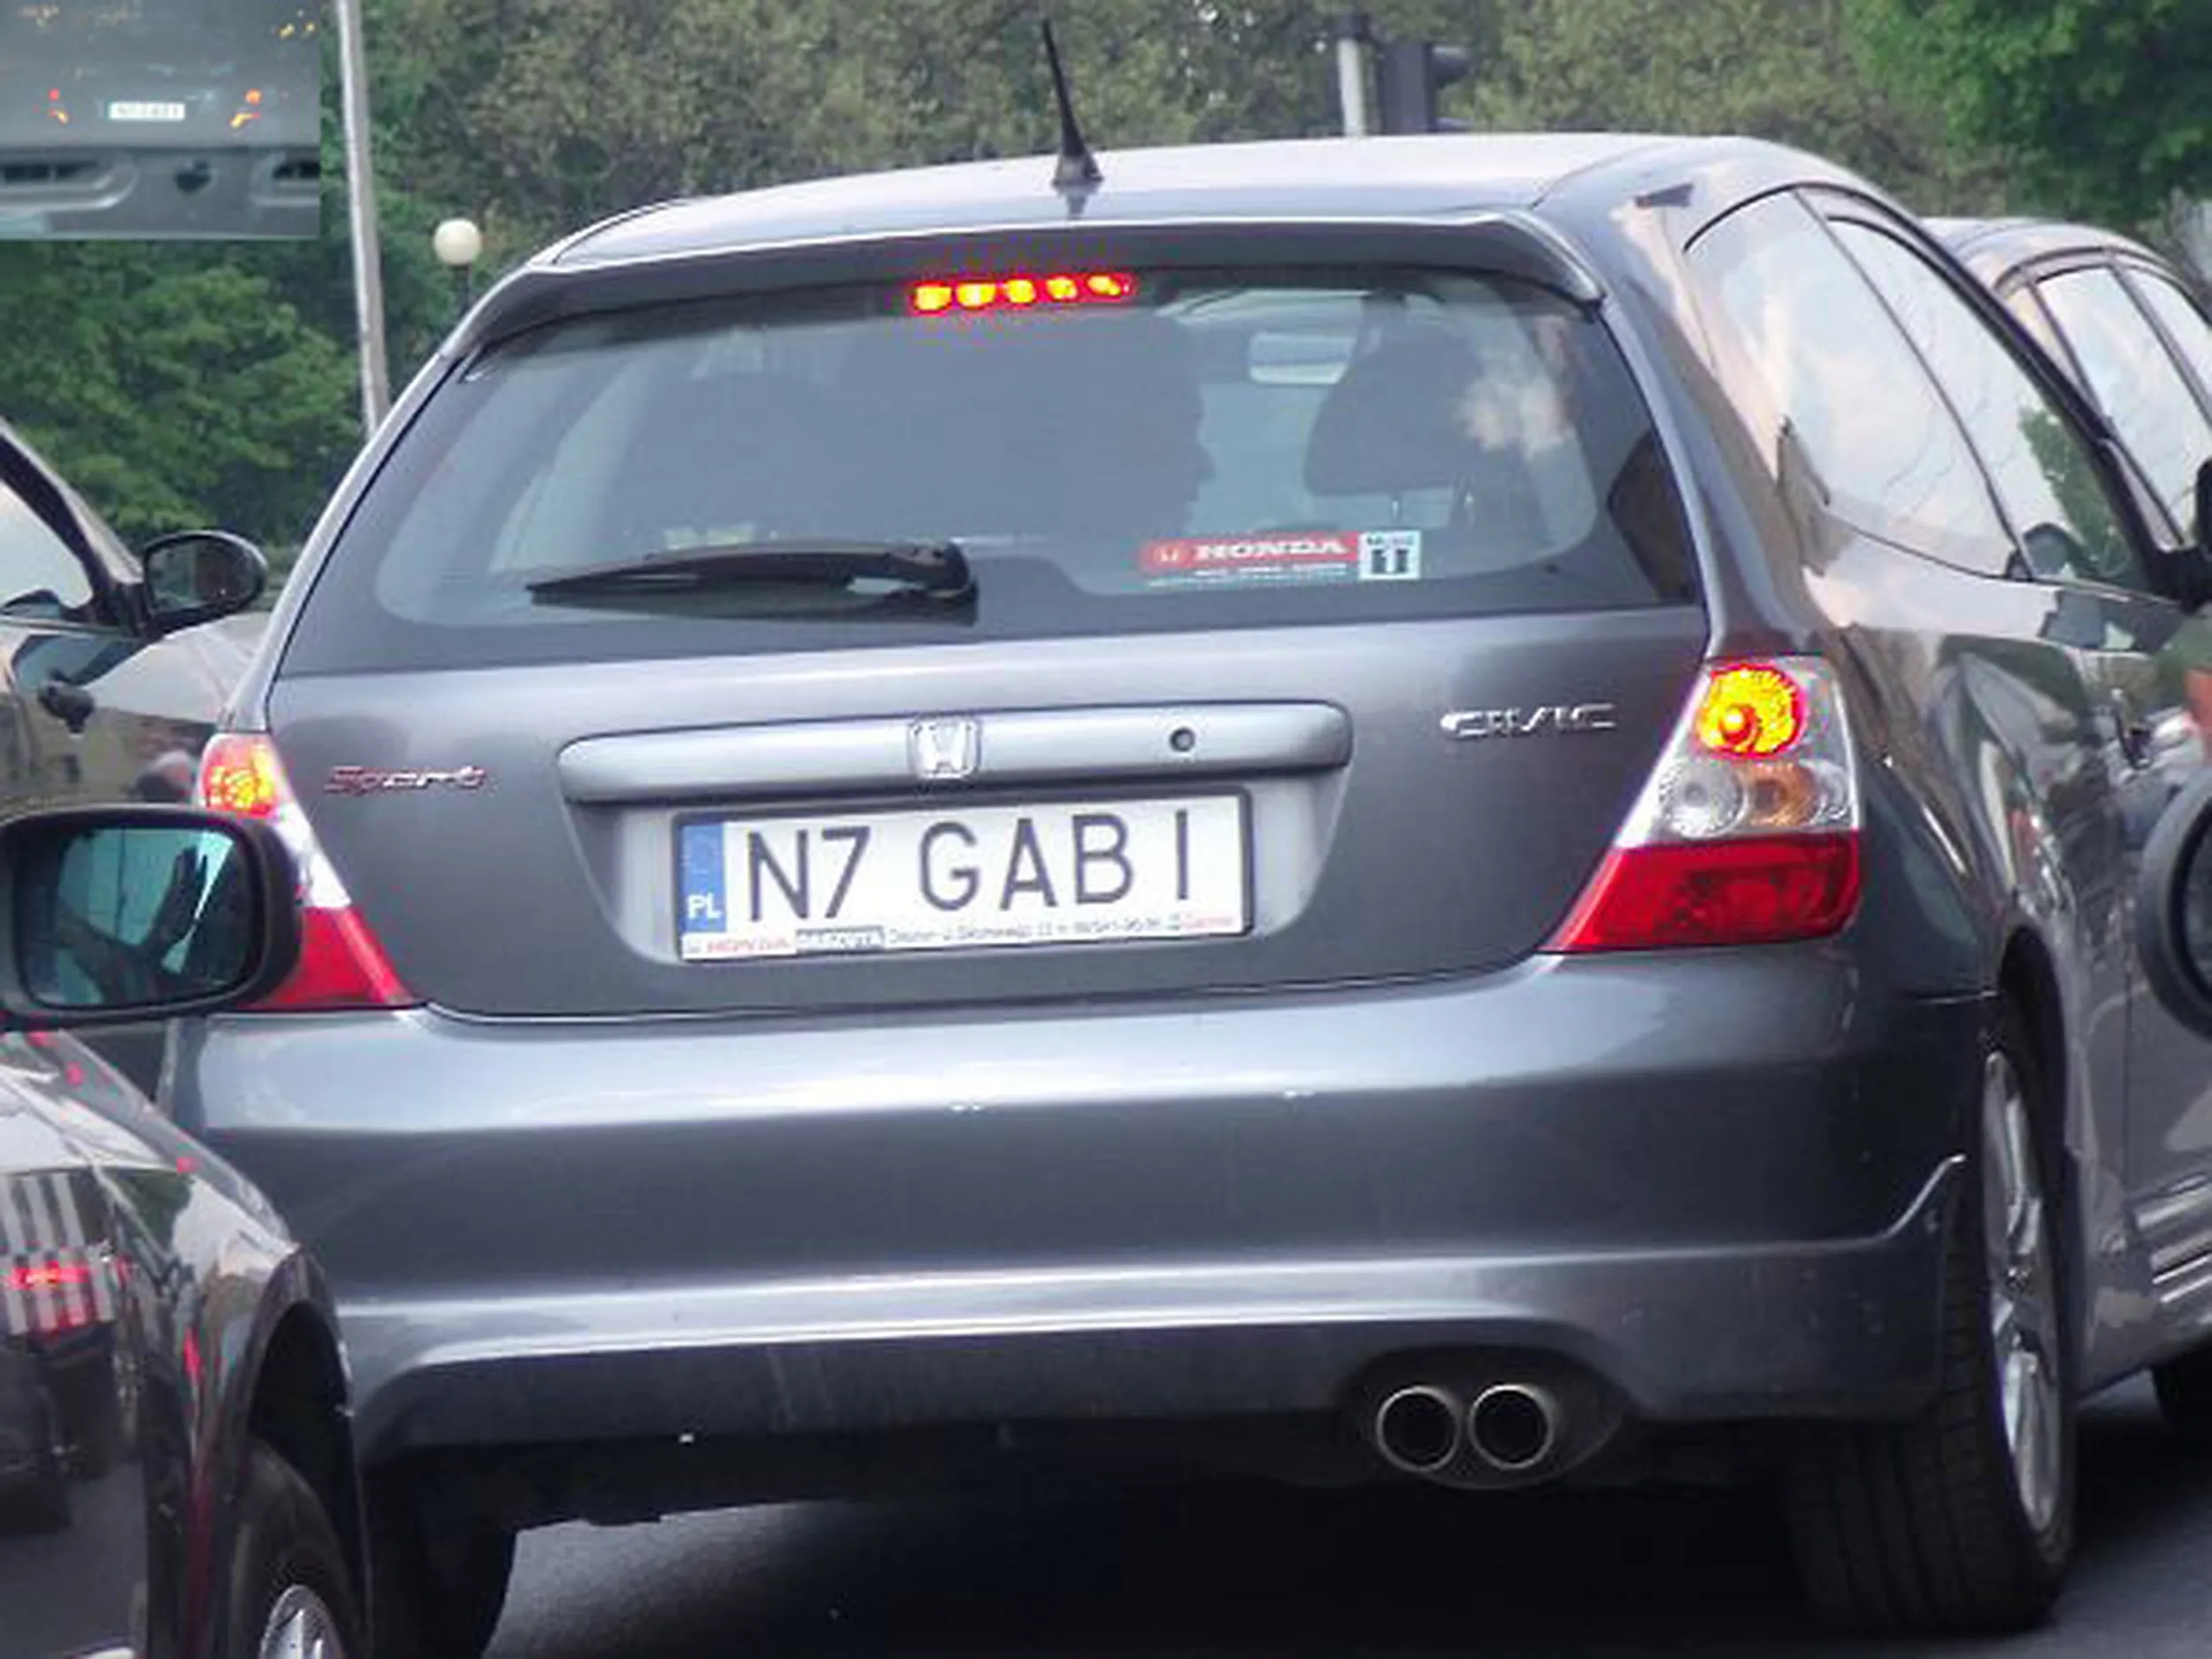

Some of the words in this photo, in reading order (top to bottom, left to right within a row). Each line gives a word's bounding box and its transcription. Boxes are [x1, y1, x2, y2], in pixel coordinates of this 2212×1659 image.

[1195, 537, 1349, 560] HONDA
[1440, 703, 1617, 737] CIVIC
[747, 826, 870, 922] N7
[687, 894, 721, 920] PL
